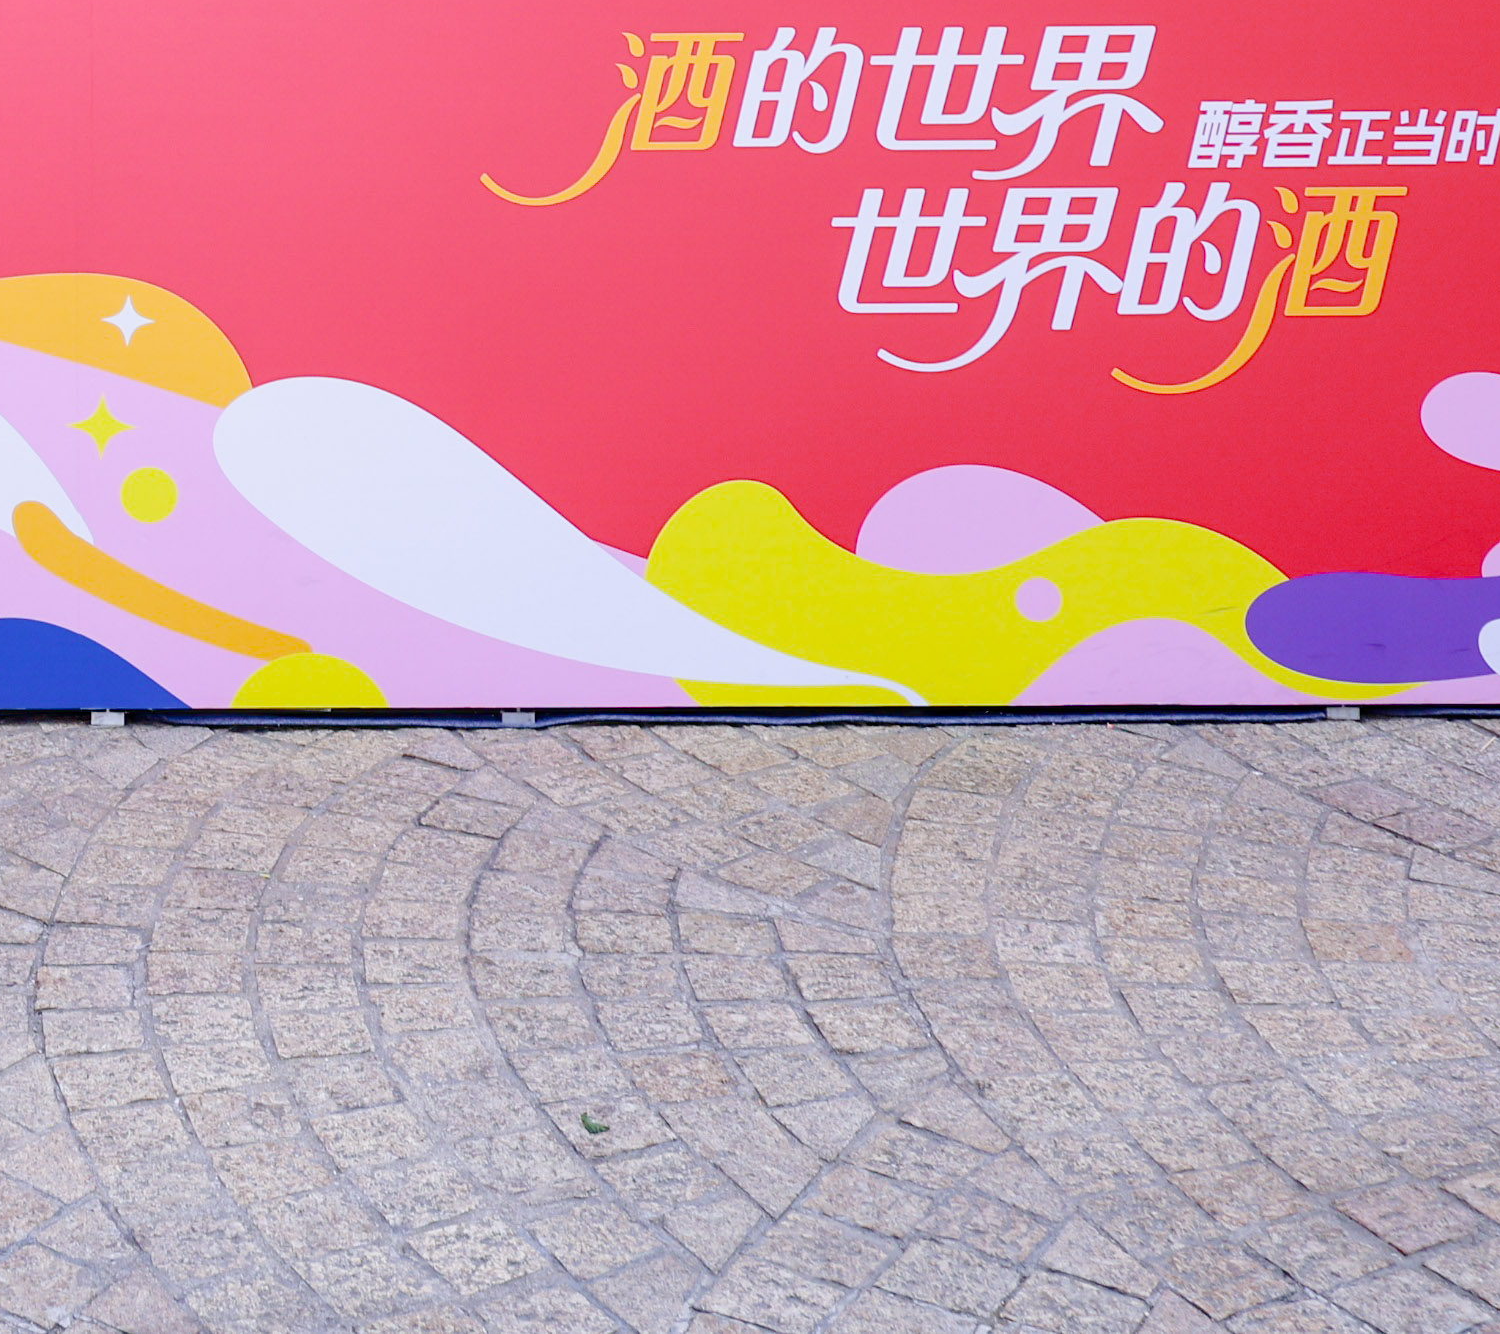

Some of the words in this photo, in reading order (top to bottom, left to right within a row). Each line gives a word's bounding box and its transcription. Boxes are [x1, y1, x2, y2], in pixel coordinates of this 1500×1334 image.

[480, 24, 1165, 207] 酒的世界
[831, 181, 1409, 395] 世界的酒
